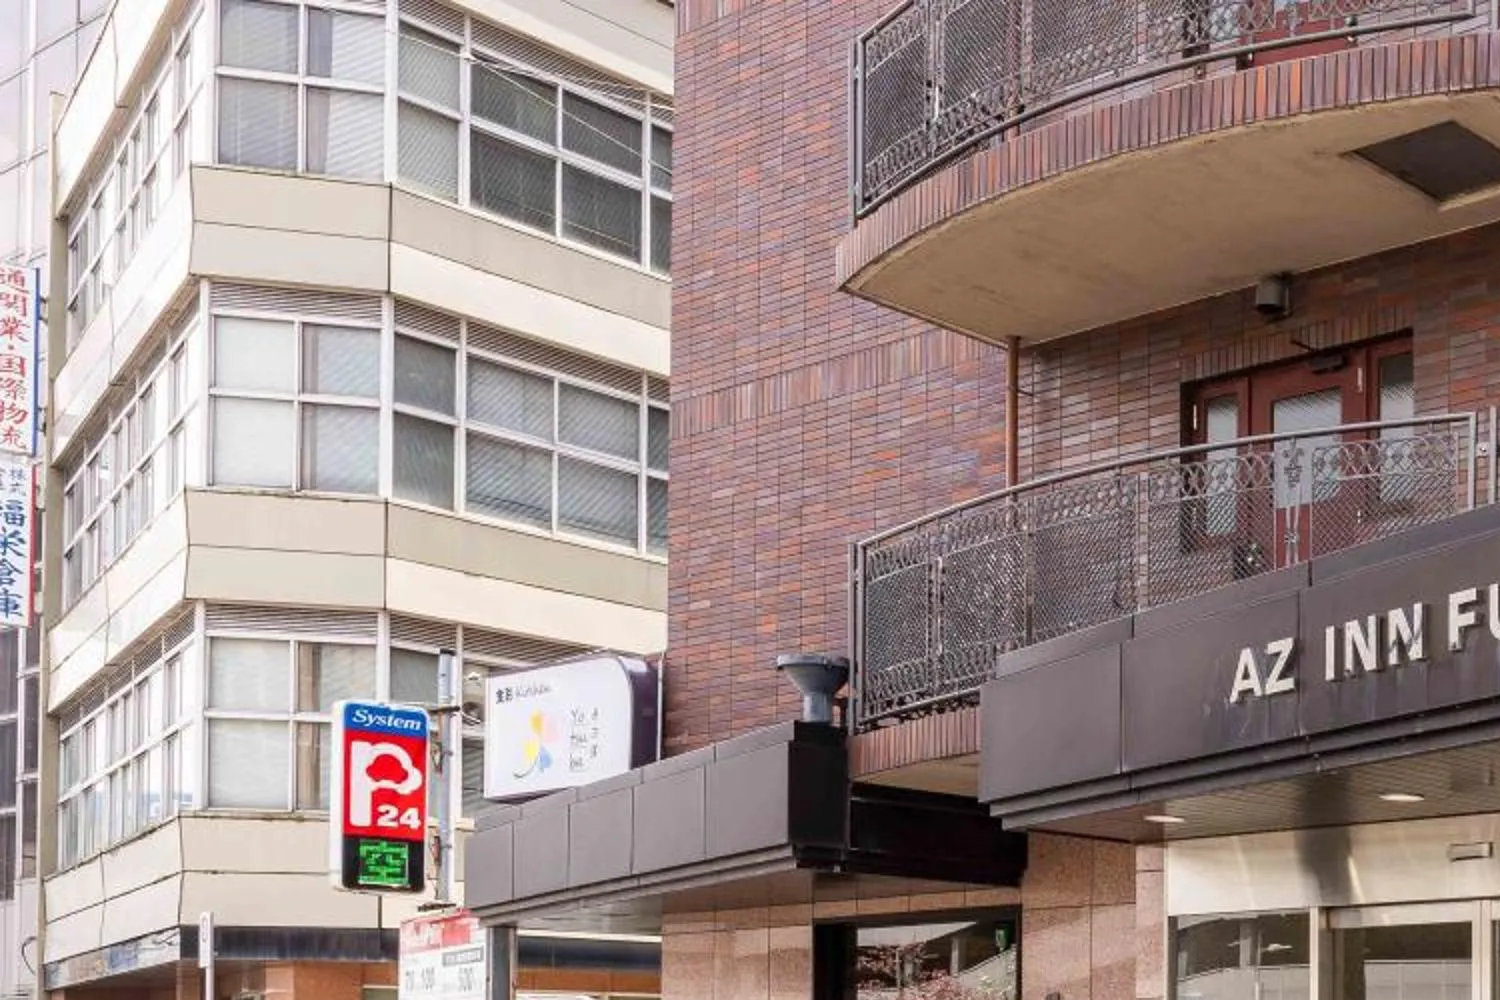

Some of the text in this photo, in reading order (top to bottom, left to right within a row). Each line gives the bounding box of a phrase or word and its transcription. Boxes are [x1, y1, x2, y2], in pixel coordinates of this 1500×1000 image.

[1230, 637, 1297, 704] AZ
[1324, 602, 1428, 682] INN
[352, 708, 422, 731] System
[376, 804, 421, 830] 24
